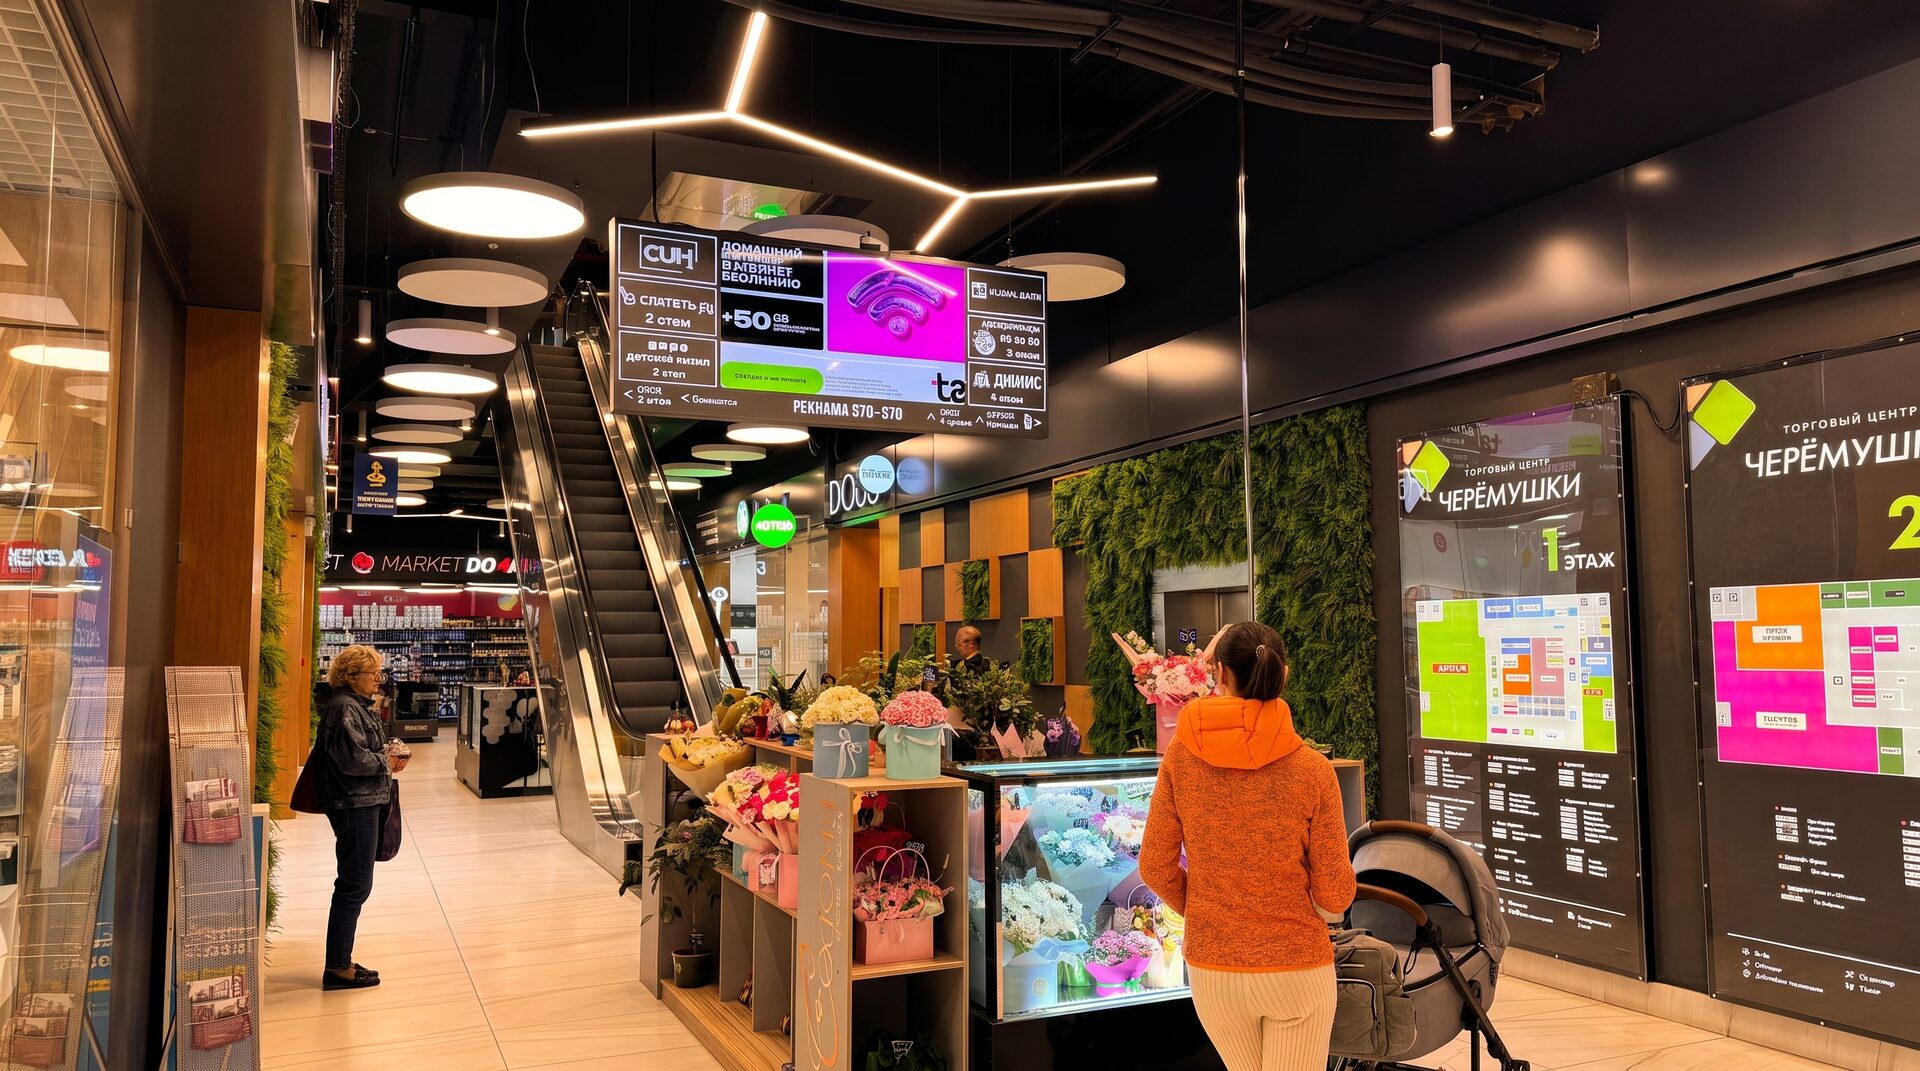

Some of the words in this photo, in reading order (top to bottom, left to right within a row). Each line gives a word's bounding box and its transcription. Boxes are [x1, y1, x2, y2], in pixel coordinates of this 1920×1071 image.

[722, 241, 803, 259] ДОМАШНИЙ
[645, 312, 655, 325] 2
[722, 309, 772, 331] +50
[652, 367, 660, 377] 2
[637, 396, 645, 404] 2
[1783, 412, 1861, 434] ТОРГОВЫЙ
[1867, 406, 1918, 423] ЦЕНТР
[1464, 461, 1515, 477] ТОРГОВЫЙ
[1519, 457, 1550, 470] ЦЕНТР
[1439, 472, 1582, 512] ЧЕРЁМУШКИ
[1888, 494, 1920, 550] 2
[1542, 528, 1559, 572] 1
[1564, 552, 1616, 571] ЭТАЖ
[382, 555, 465, 572] MARKET
